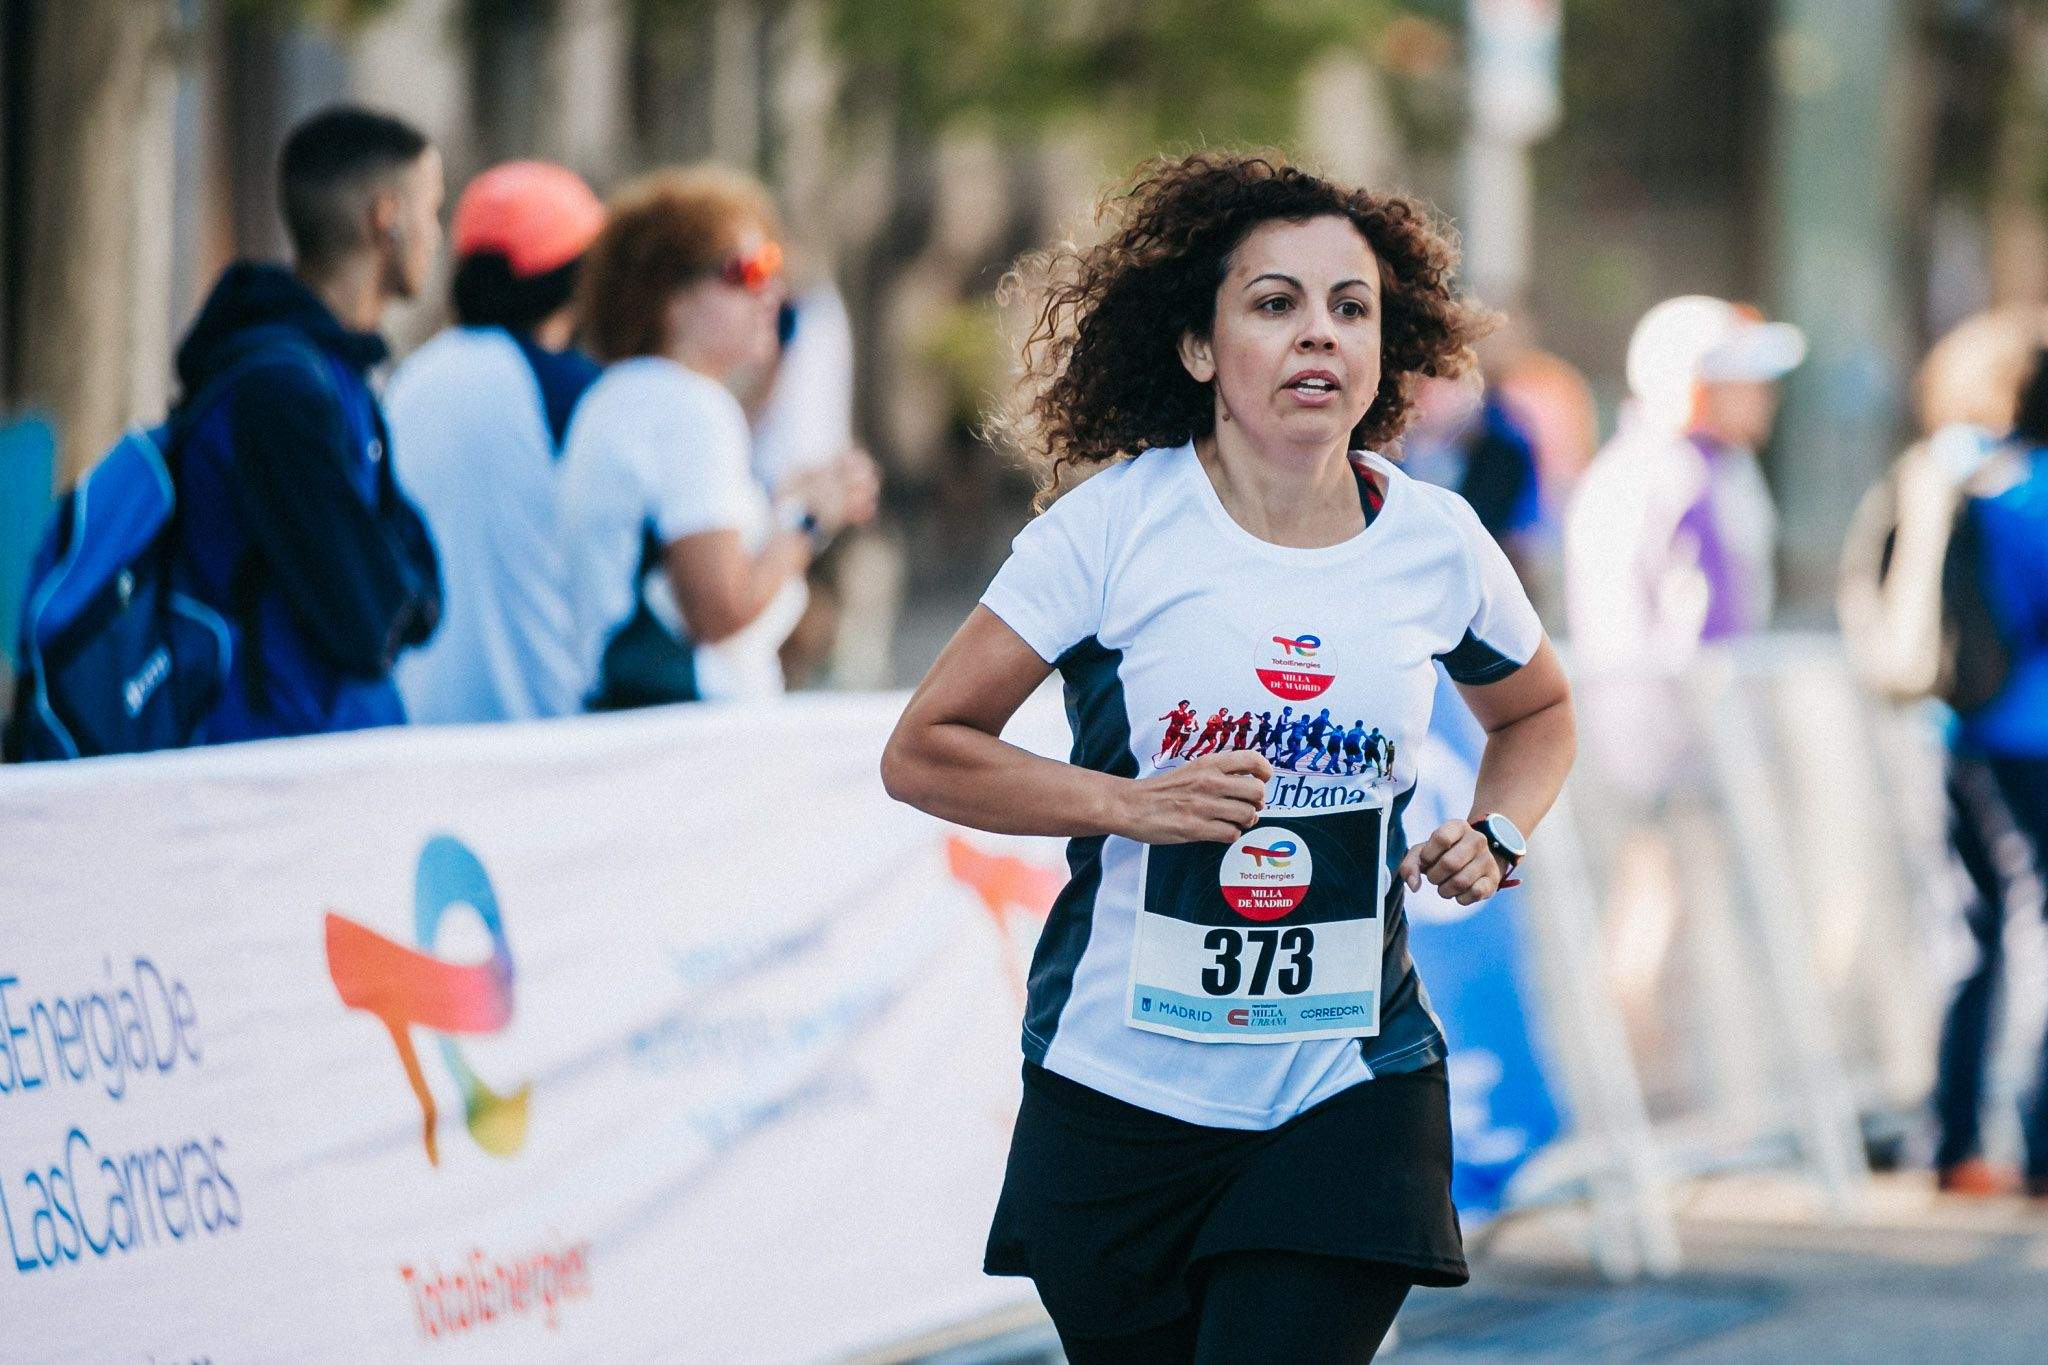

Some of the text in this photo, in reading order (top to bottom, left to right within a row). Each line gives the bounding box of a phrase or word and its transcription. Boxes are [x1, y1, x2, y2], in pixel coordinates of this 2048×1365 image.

[1272, 658, 1321, 669] TotalEnergies
[1281, 673, 1310, 683] MILLA
[1271, 681, 1321, 692] DE MADRID
[1240, 872, 1295, 881] TotalEnergies
[1251, 889, 1283, 898] MILLA
[1238, 898, 1294, 908] DE MADRID
[1201, 927, 1315, 996] 373
[1159, 1002, 1212, 1022] MADRID
[1252, 1009, 1283, 1018] MILLA
[0, 1128, 242, 1272] LasCarreras
